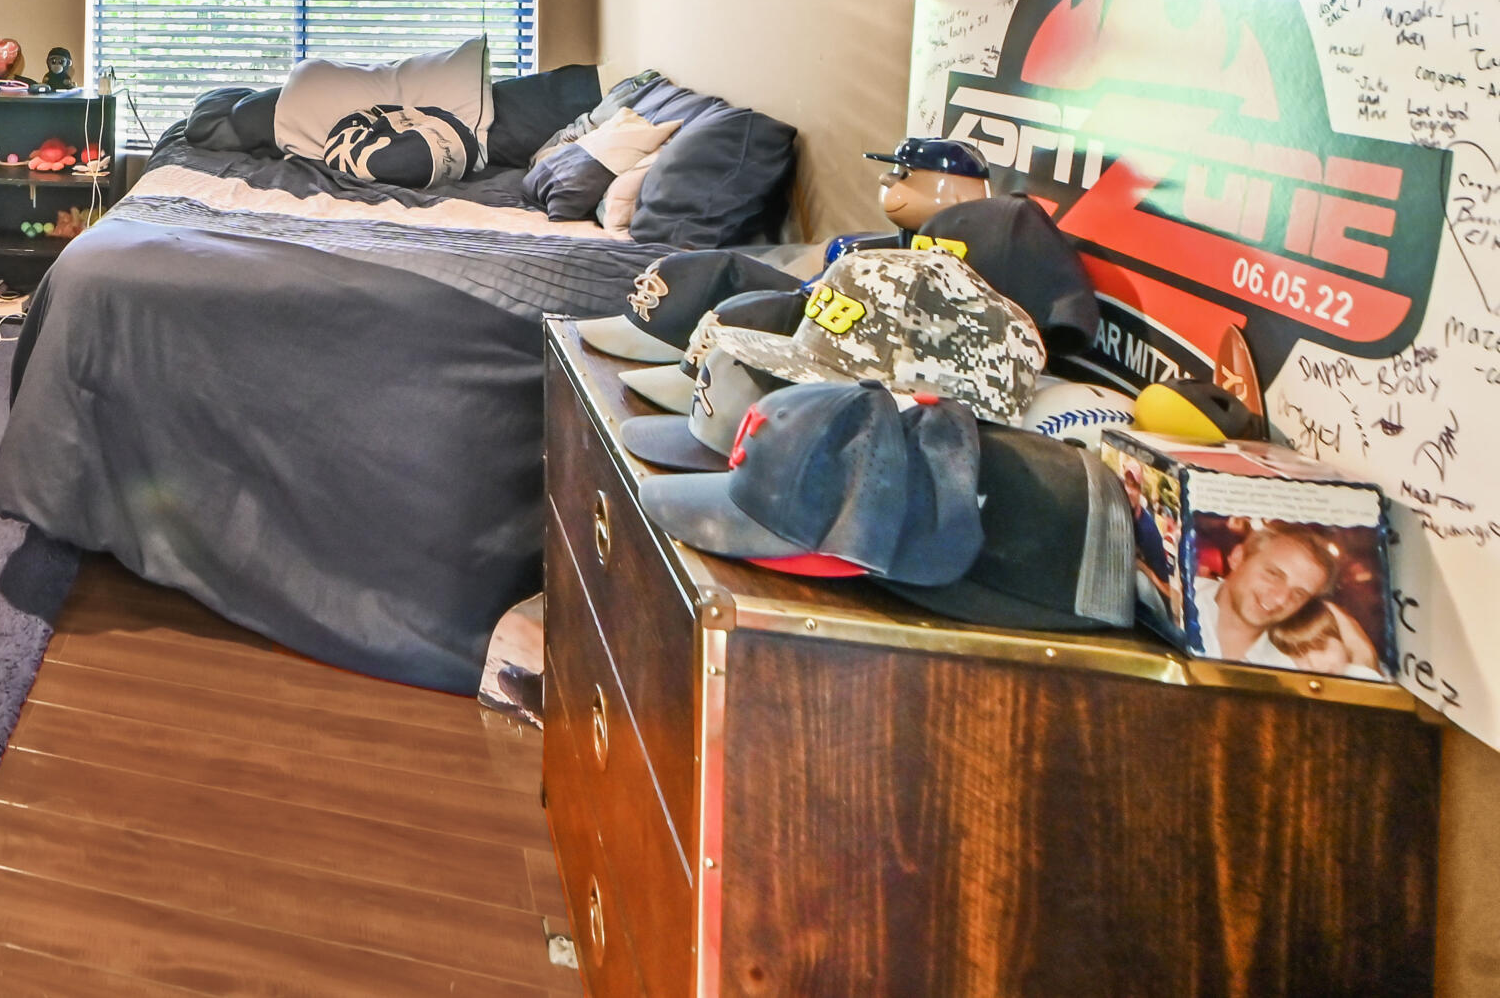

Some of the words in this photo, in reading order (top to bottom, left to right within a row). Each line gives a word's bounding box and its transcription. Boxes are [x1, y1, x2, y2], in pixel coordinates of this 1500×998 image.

[1451, 11, 1480, 39] Hi
[947, 86, 1105, 190] ESPN
[805, 281, 867, 335] CB
[1231, 257, 1355, 328] 06.05.22
[1093, 317, 1122, 363] AR
